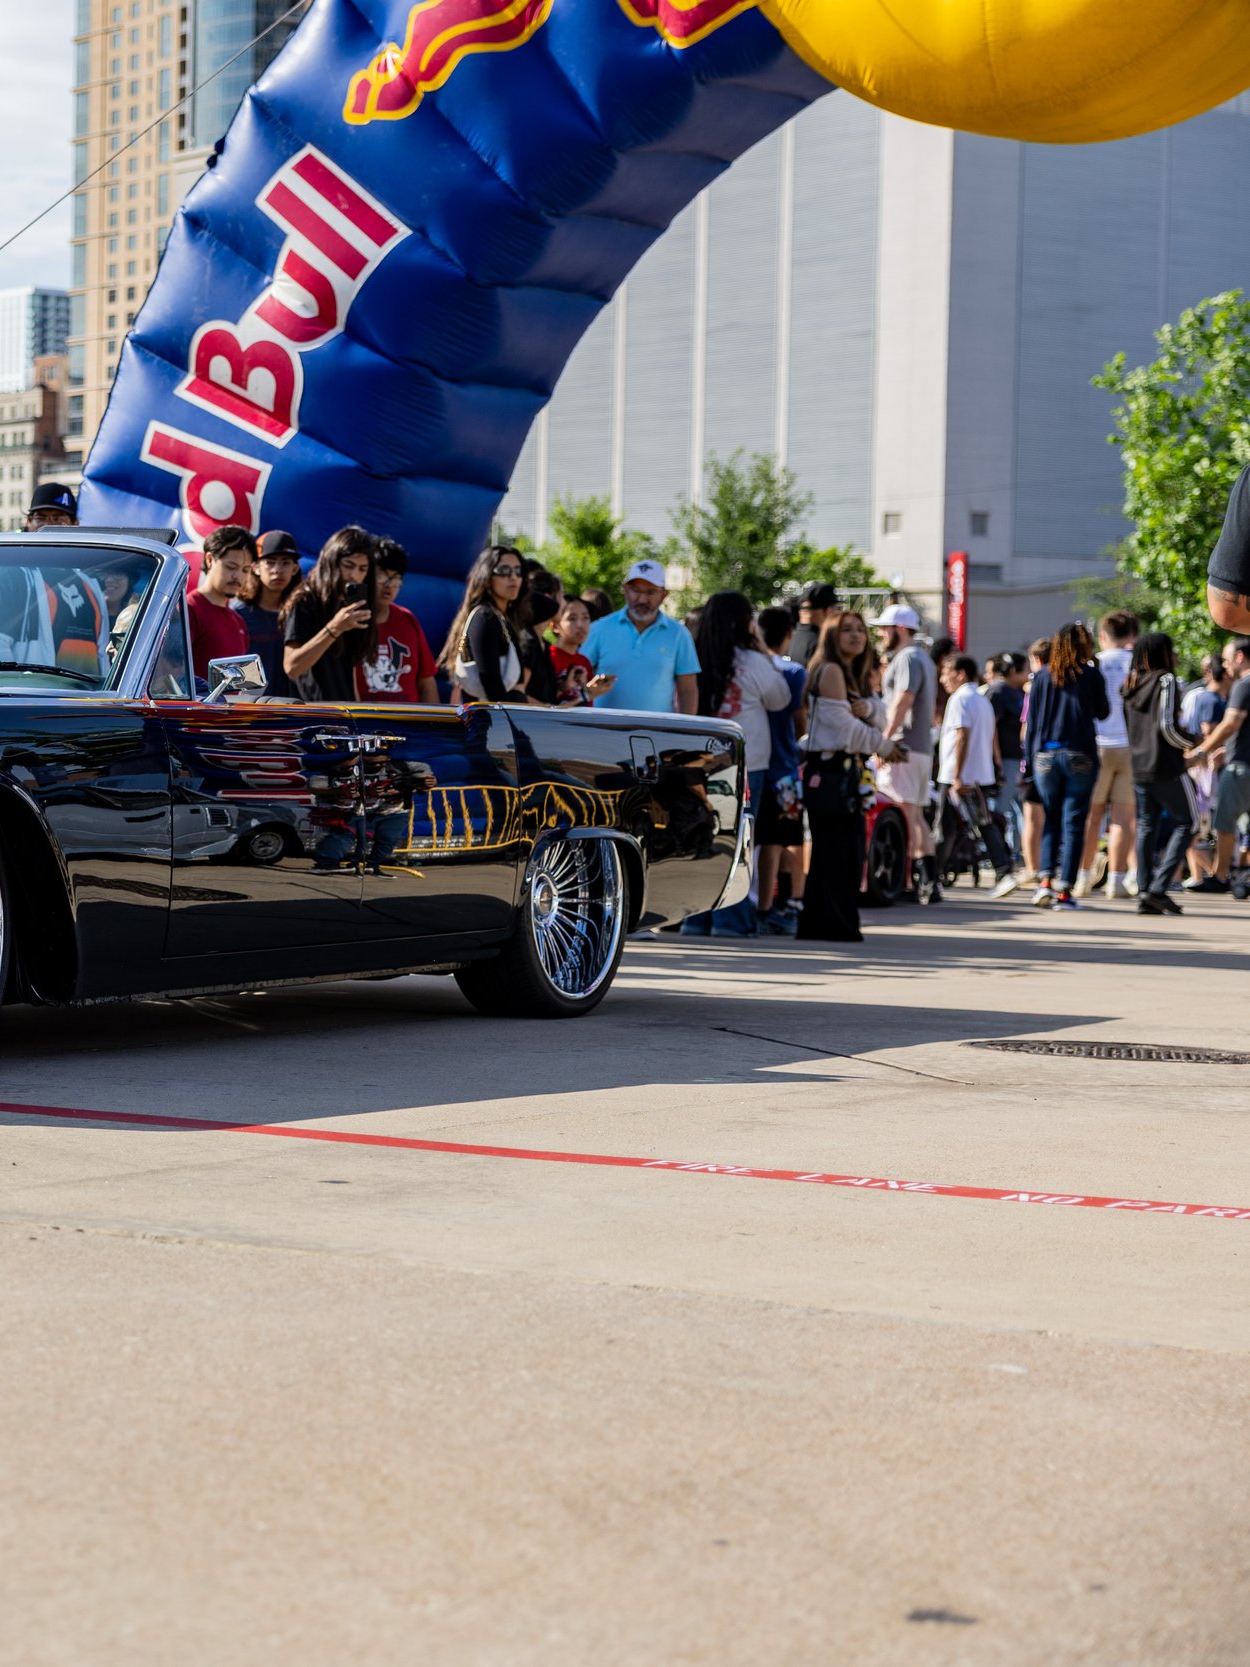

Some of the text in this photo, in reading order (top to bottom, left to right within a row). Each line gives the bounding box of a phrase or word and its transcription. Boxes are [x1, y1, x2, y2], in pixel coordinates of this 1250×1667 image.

[177, 145, 410, 445] Bull
[640, 1159, 774, 1176] FIRE
[794, 1173, 956, 1193] LANE
[1000, 1193, 1086, 1205] NO
